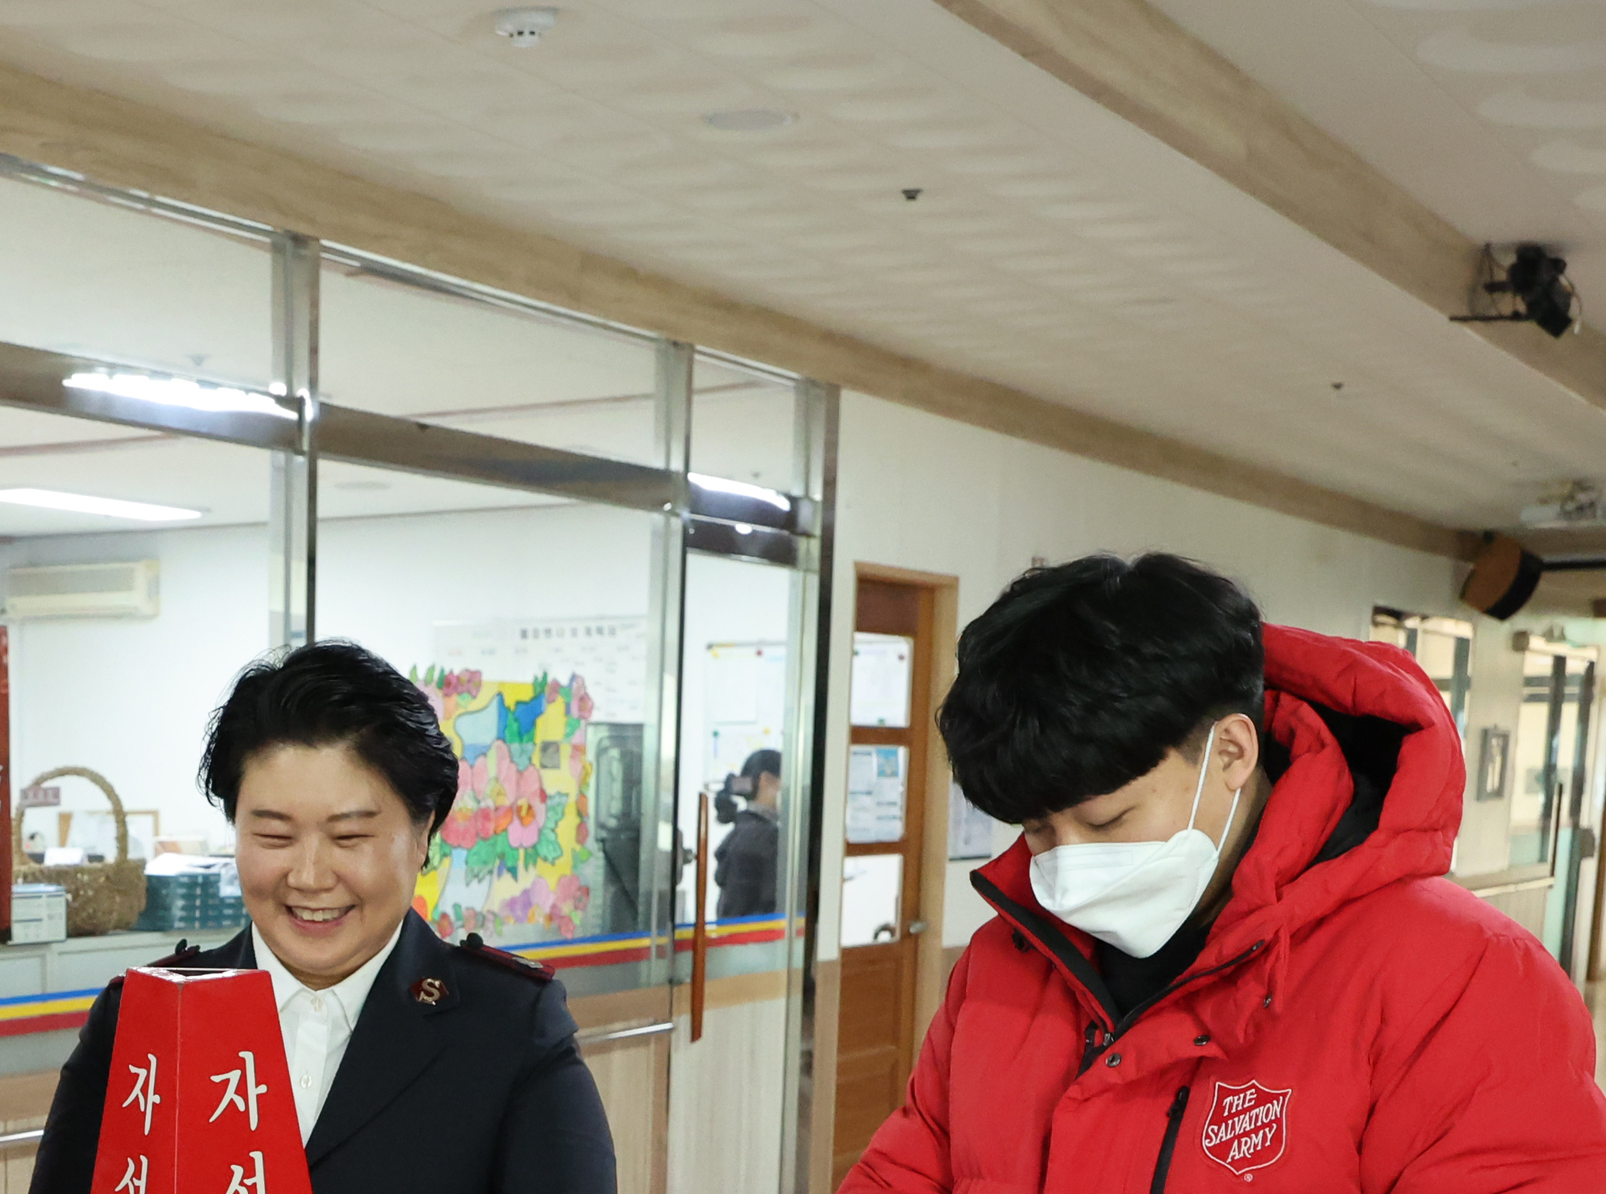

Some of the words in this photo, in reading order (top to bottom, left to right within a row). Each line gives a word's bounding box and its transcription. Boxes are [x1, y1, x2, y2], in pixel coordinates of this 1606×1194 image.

[1205, 1096, 1283, 1148] SALVATION
[1223, 1089, 1258, 1117] THE
[1226, 1123, 1278, 1164] ARMY
